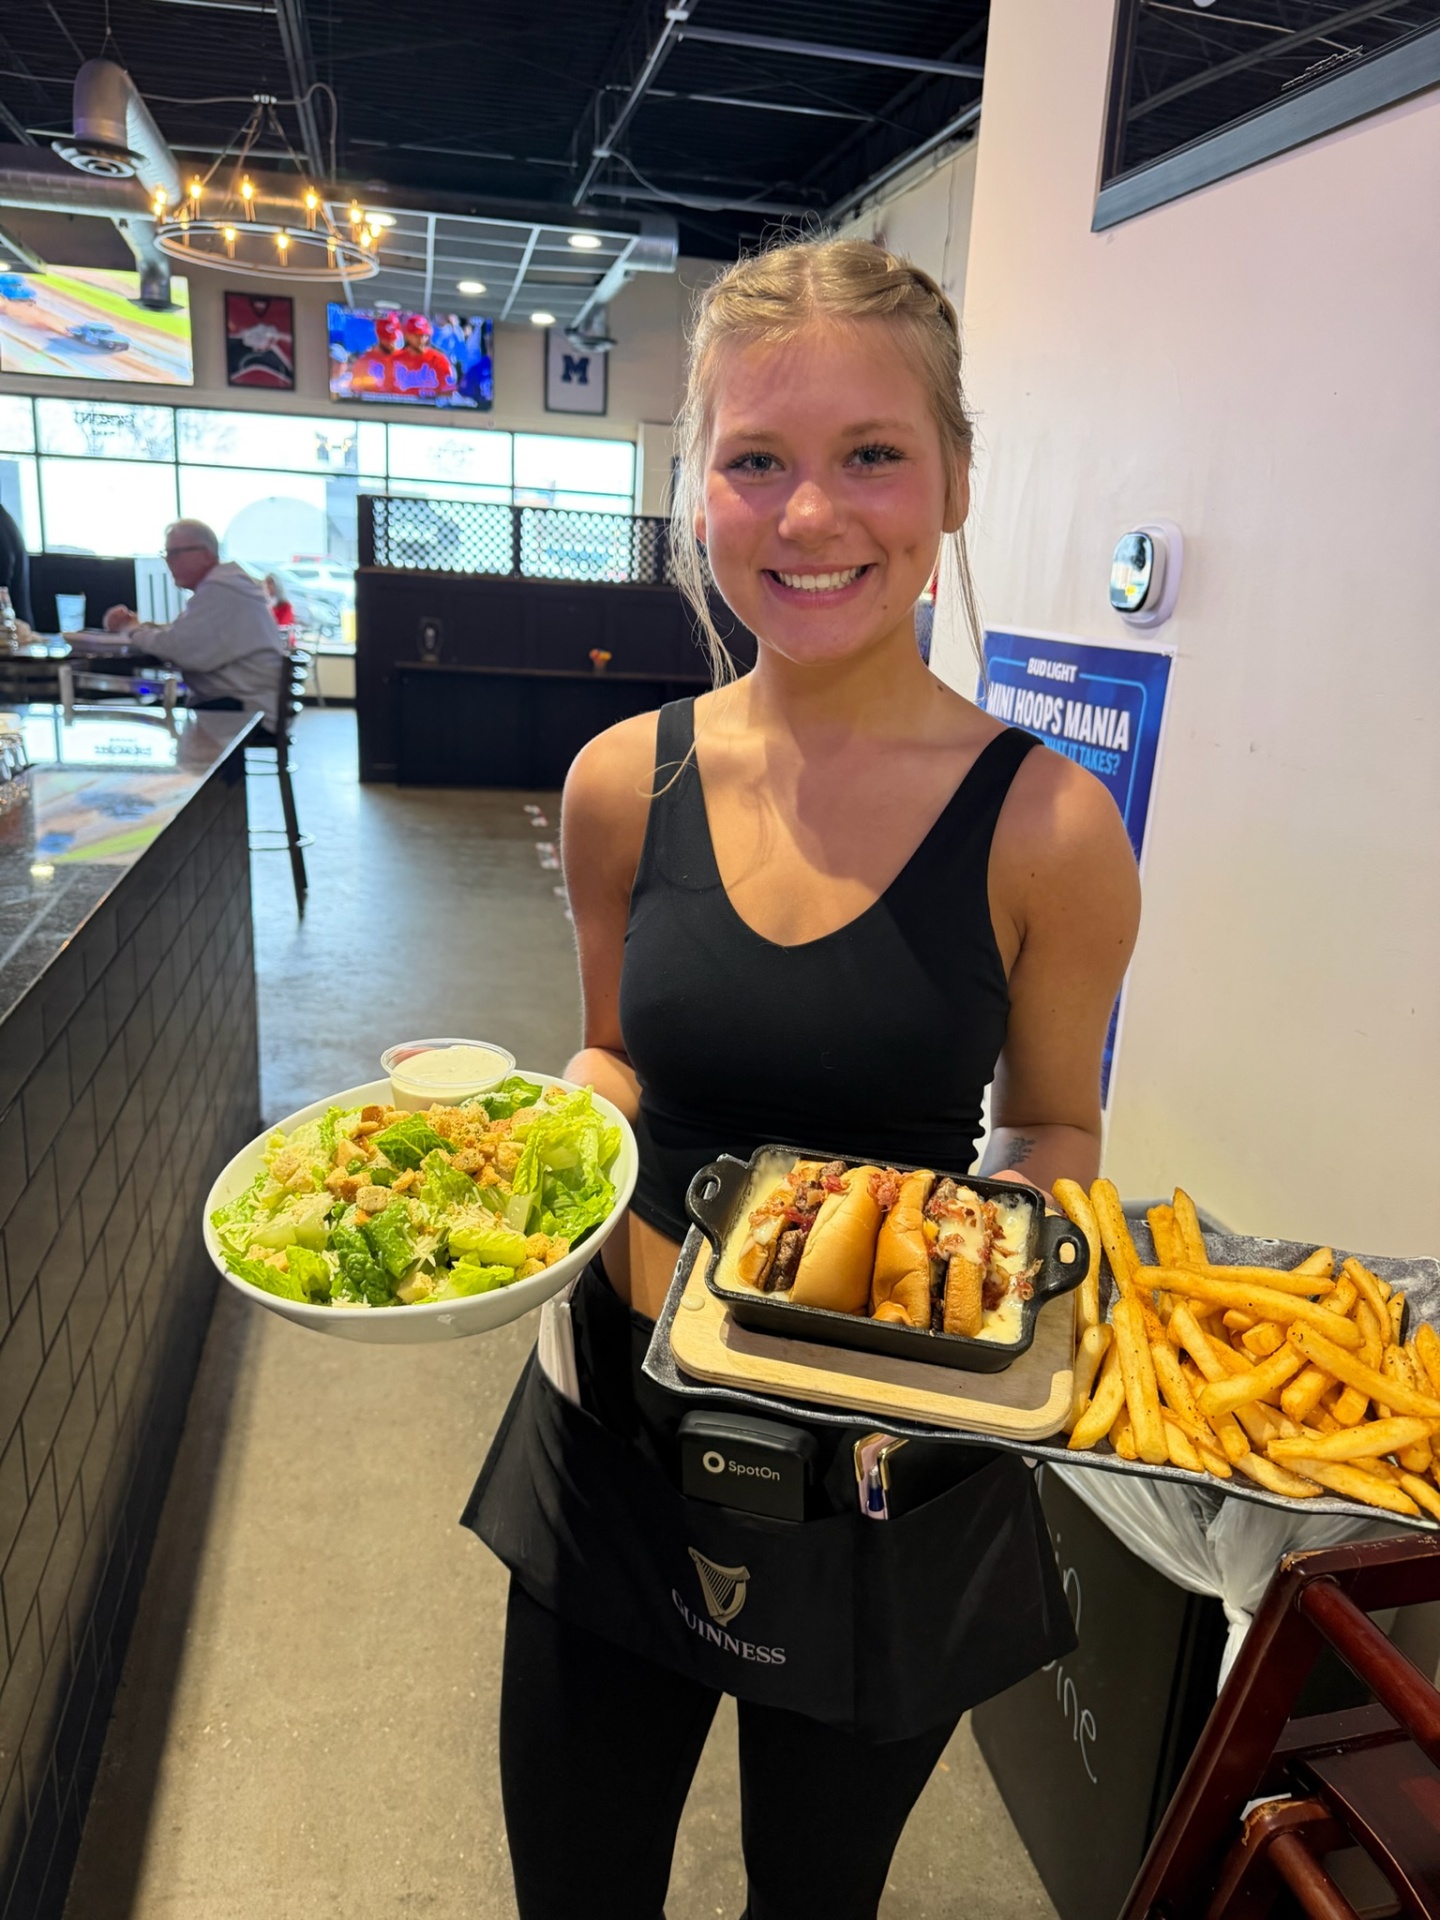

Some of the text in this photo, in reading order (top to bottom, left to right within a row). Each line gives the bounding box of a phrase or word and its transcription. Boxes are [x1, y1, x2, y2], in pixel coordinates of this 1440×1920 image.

[562, 354, 590, 385] M
[1027, 657, 1078, 683] BUD LIGHT
[986, 681, 1130, 752] MINI HOOPS MANIA
[1078, 745, 1121, 776] TAKES?
[728, 1460, 780, 1481] SpotOn
[671, 1588, 786, 1664] GUINNESS
